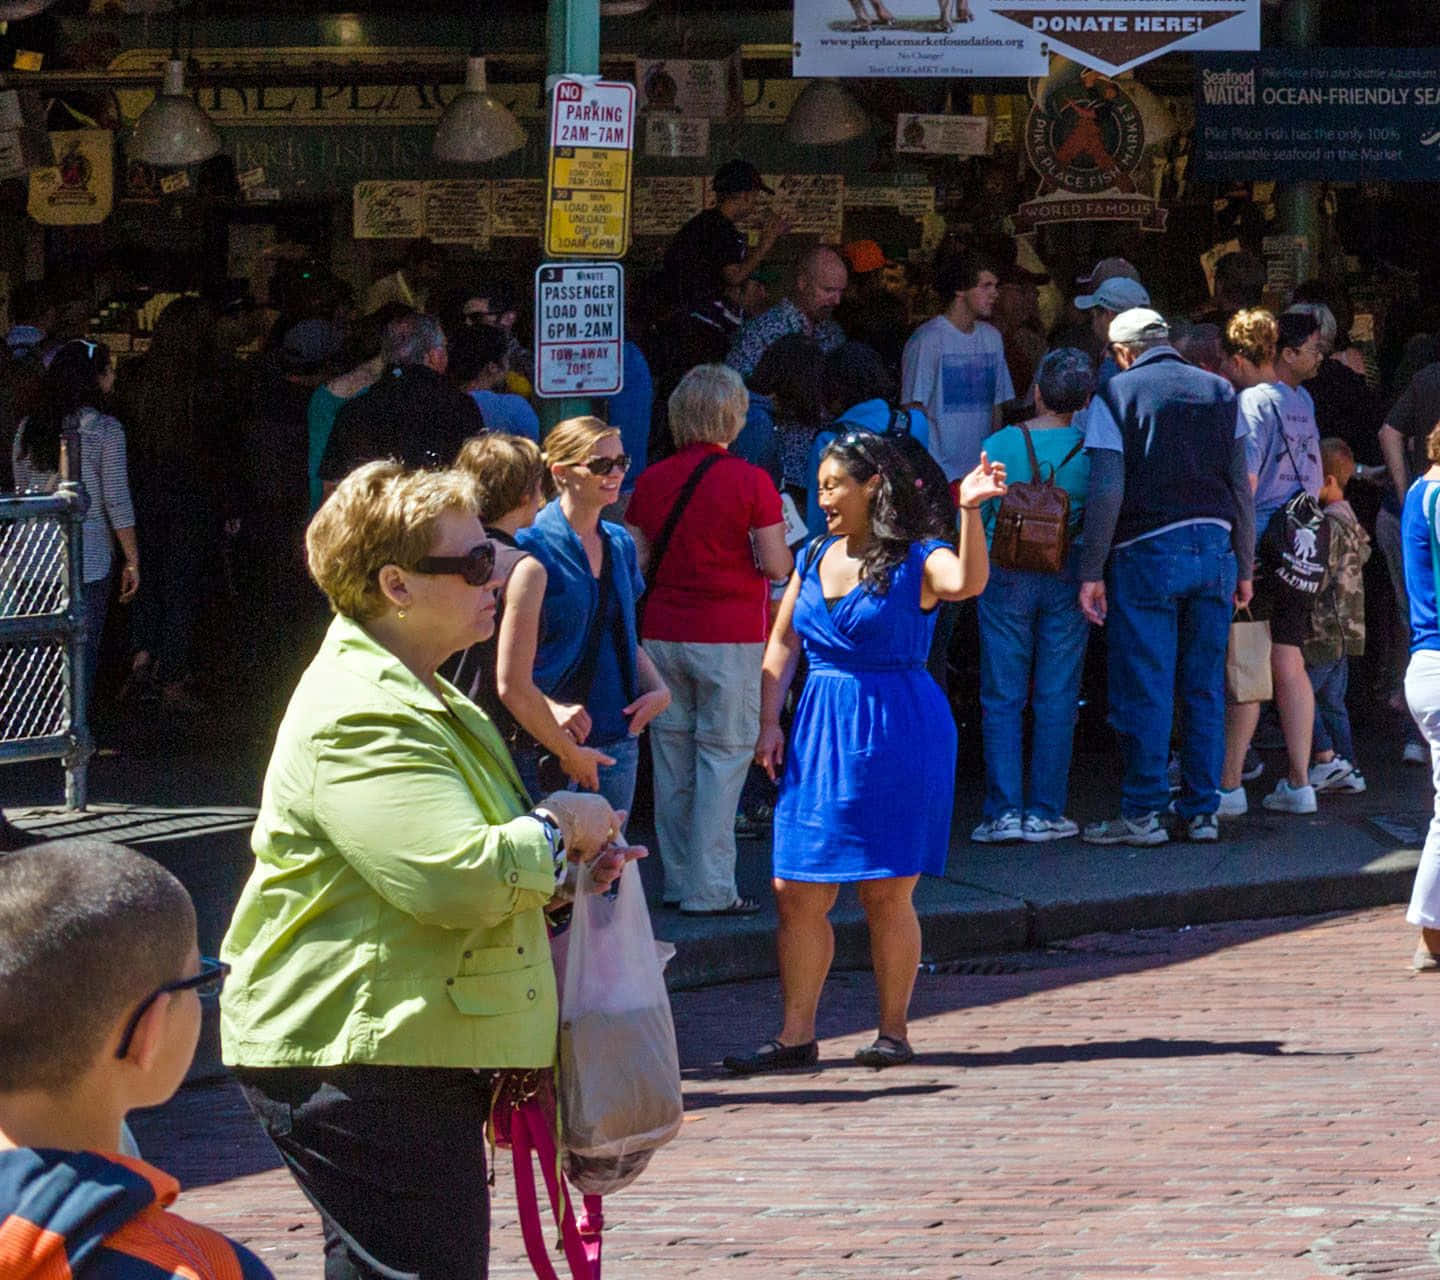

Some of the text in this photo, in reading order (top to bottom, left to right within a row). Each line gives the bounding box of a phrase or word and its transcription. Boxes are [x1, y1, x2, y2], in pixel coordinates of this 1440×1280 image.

[1032, 16, 1203, 32] DONATE HERE!
[1202, 68, 1255, 86] Seafood
[560, 85, 581, 102] NO
[1203, 86, 1255, 105] WATCH
[1262, 88, 1409, 105] OCEAN-FRIENDLY
[566, 104, 623, 122] PARKING
[562, 125, 624, 143] 2AM-7AM
[1033, 118, 1048, 155] PIKE
[1204, 127, 1229, 140] Pike
[1231, 127, 1262, 140] Place
[1264, 127, 1290, 140] Fish
[1314, 127, 1334, 140] the
[1273, 149, 1321, 161] seafood
[1323, 149, 1334, 161] in
[1336, 149, 1358, 161] the
[1360, 149, 1402, 161] Market
[1025, 202, 1151, 218] WORLD FAMOUS
[545, 285, 615, 300] PASSENGER
[546, 303, 613, 319] LOAD ONLY
[547, 322, 613, 339] 6PM-2AM
[551, 347, 609, 361] TOW-AWAY
[1274, 567, 1320, 594] ALUMNI
